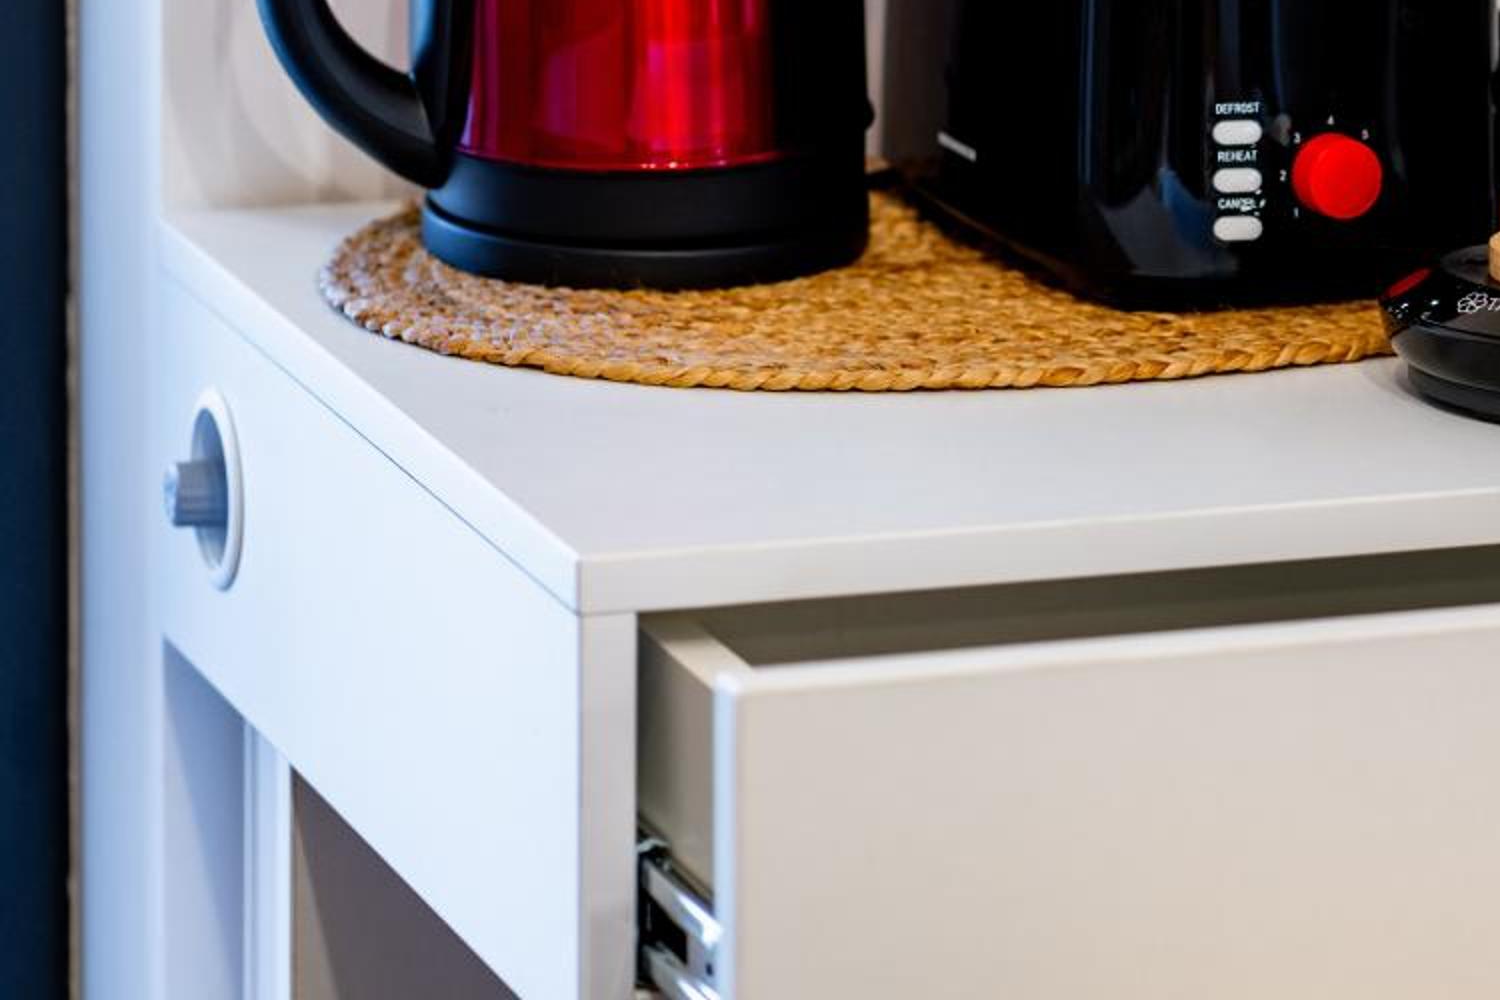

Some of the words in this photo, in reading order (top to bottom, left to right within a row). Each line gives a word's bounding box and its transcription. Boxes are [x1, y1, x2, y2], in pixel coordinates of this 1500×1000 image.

[1215, 101, 1260, 115] DEFROST
[1217, 149, 1257, 163] REHEAT
[1280, 169, 1287, 182] 2
